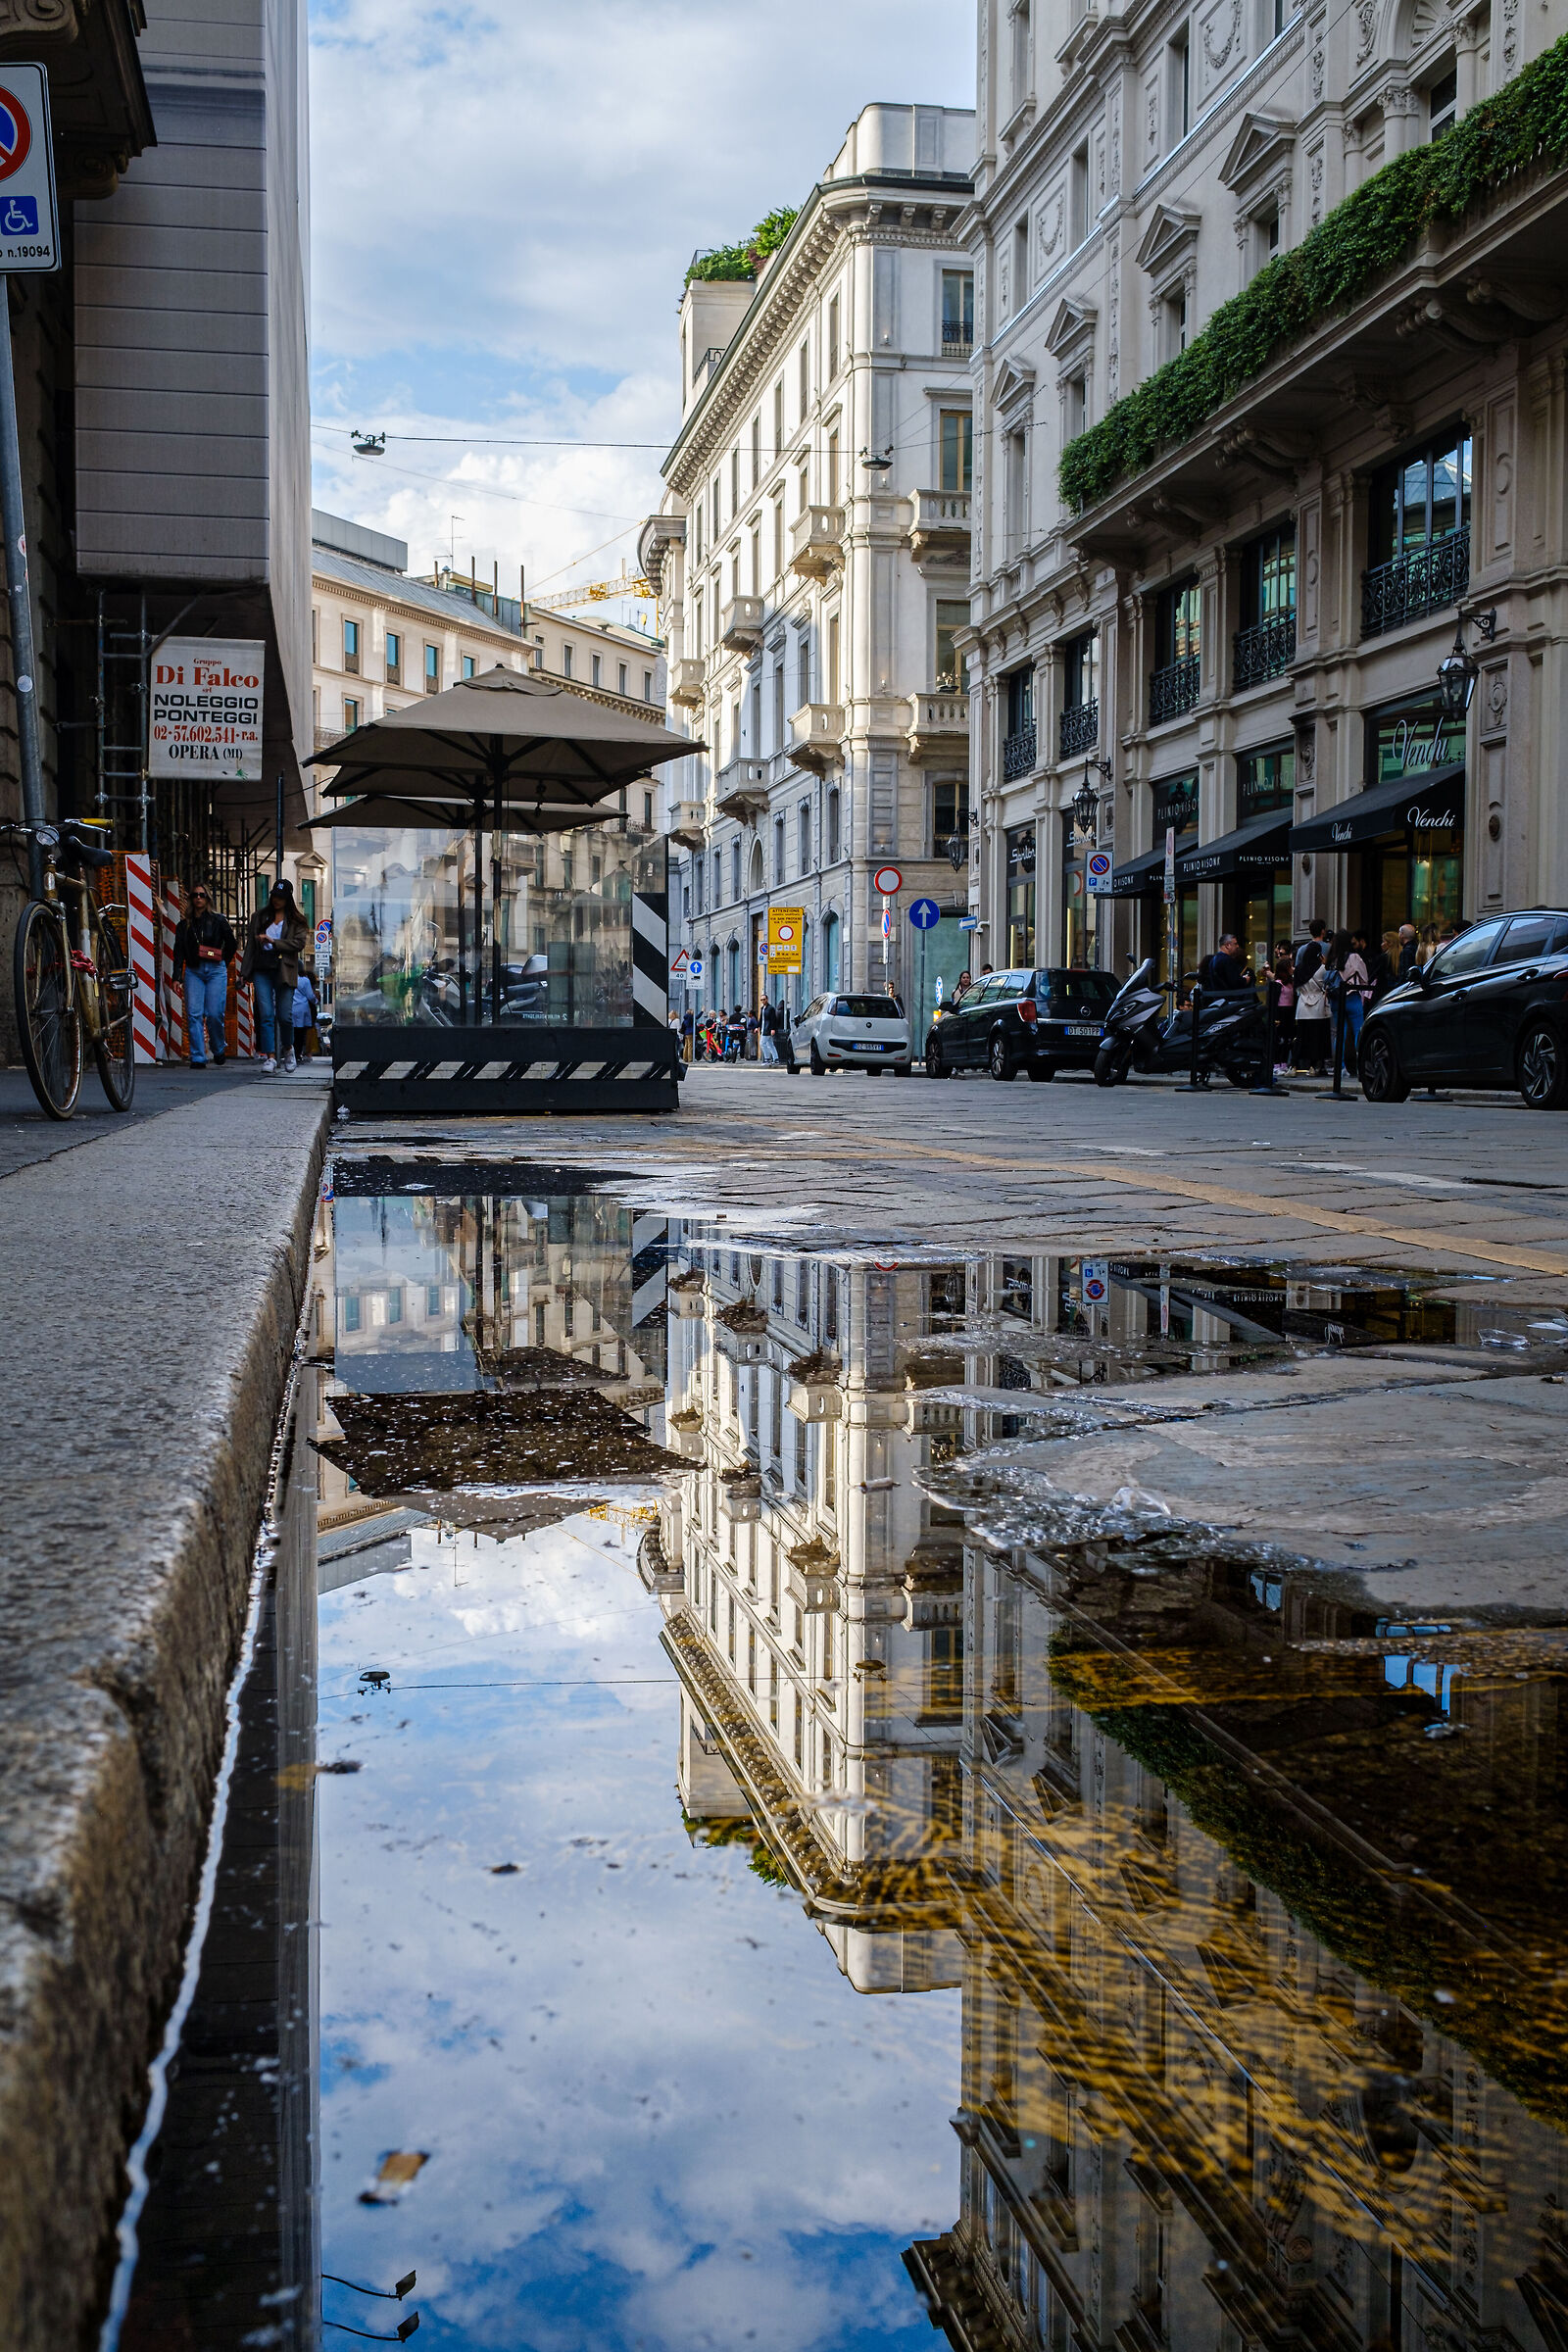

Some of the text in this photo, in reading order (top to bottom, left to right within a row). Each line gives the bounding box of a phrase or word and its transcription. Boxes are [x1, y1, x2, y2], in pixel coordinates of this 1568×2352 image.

[7, 245, 51, 258] n.19094
[193, 658, 222, 666] Gruppo
[155, 665, 260, 688] Di Falco
[154, 694, 259, 710] NOLEGGIO
[154, 709, 258, 724] PONTEGGI
[1393, 715, 1449, 771] Venchi
[169, 745, 243, 761] OPERA (MI)
[1407, 807, 1456, 828] Venchi
[1331, 822, 1353, 843] Venchi
[1183, 860, 1200, 872] PLINIO
